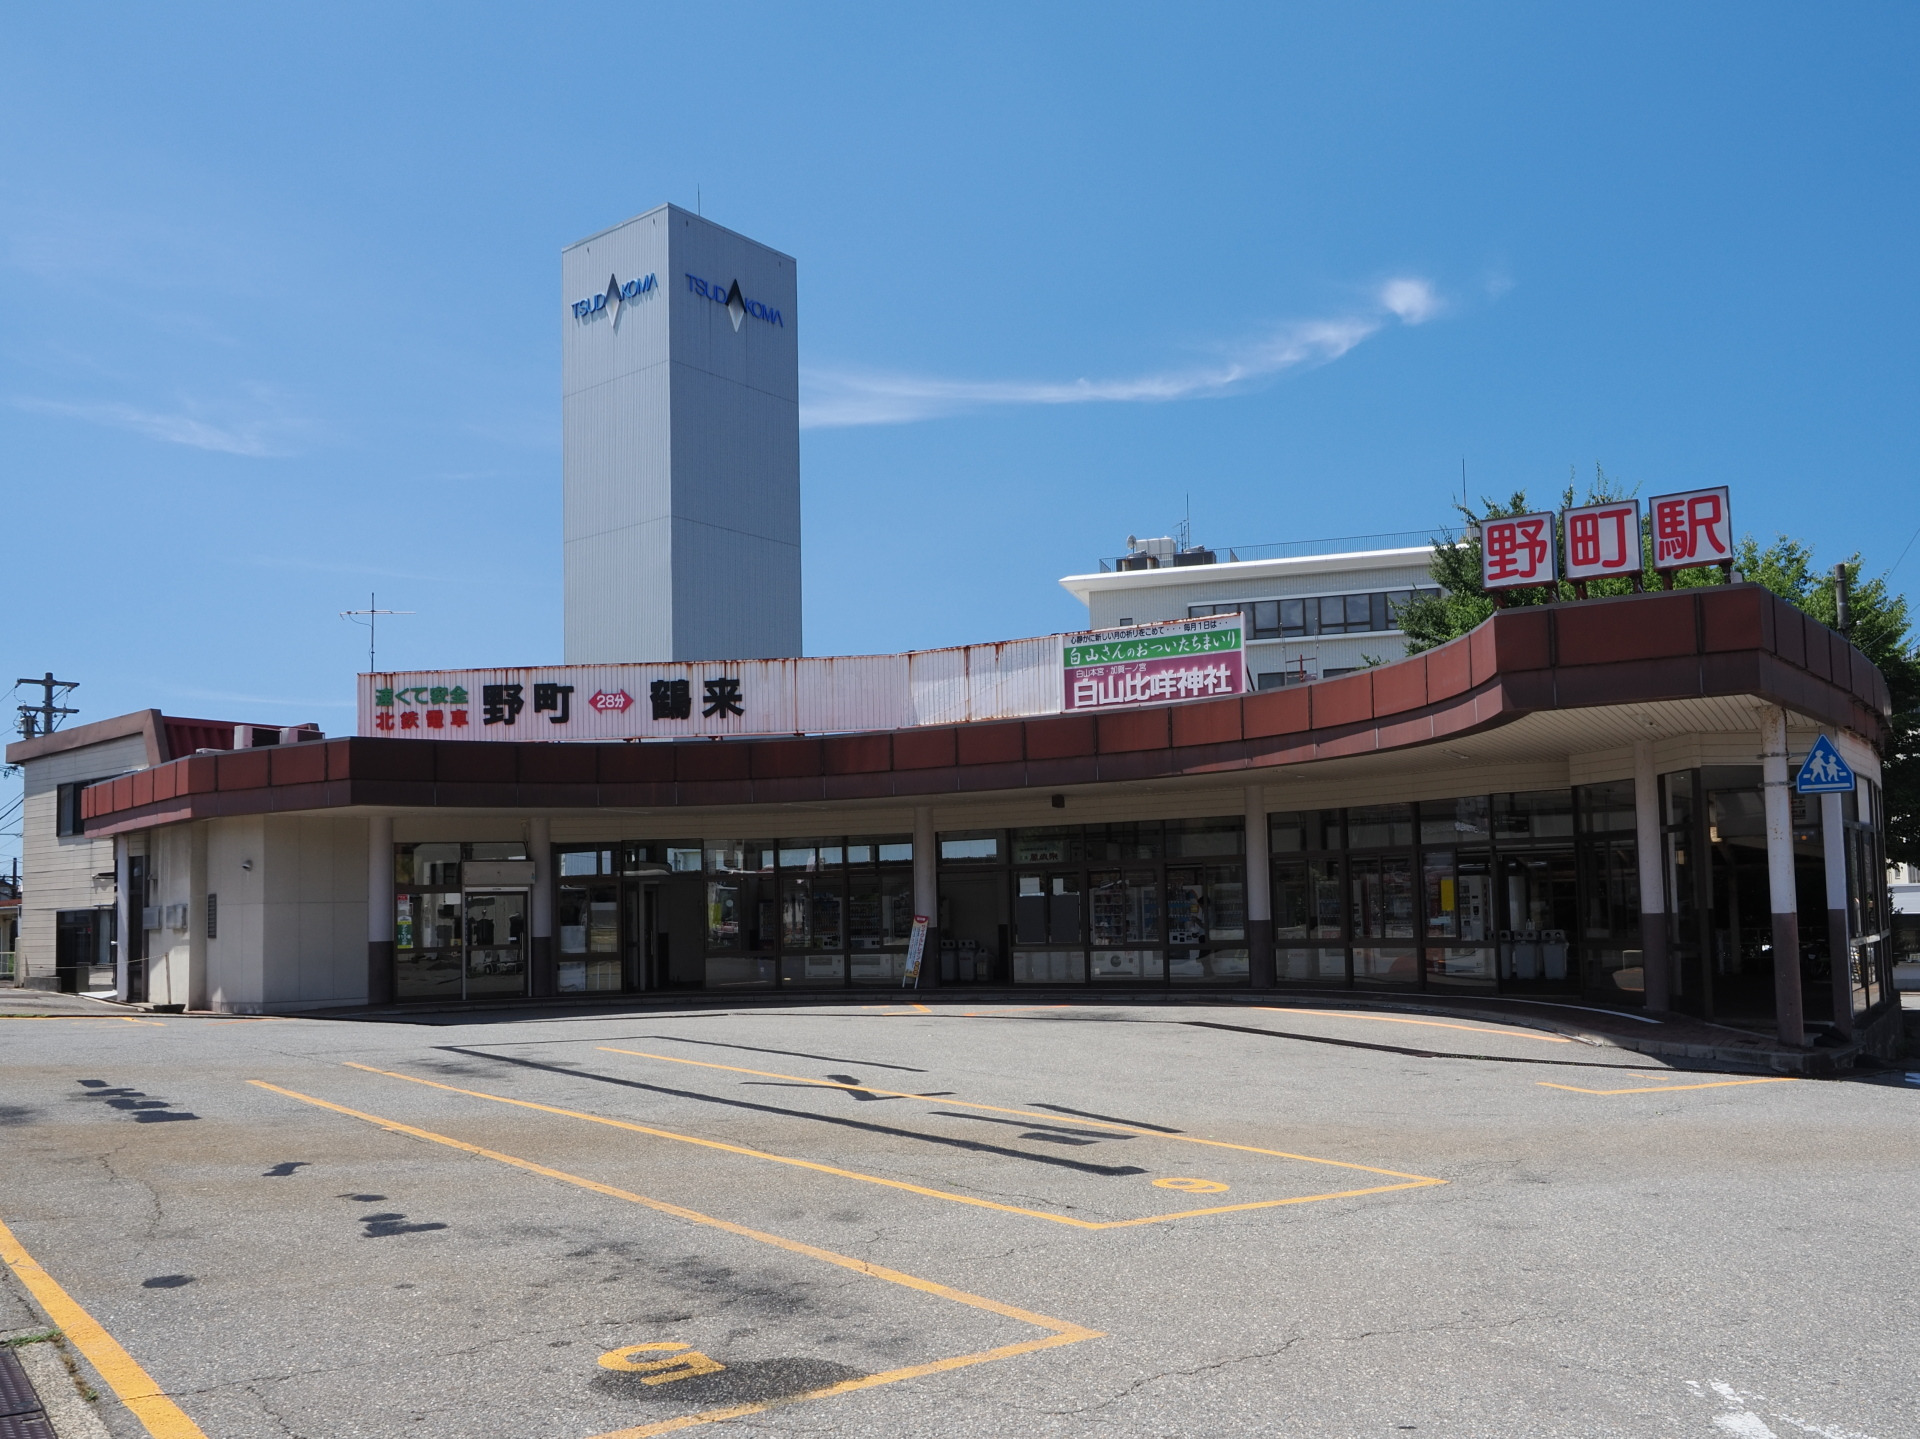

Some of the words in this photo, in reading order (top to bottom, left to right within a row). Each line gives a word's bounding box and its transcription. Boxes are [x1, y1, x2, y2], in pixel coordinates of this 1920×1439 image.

[1487, 494, 1726, 581] 野町駅
[1070, 631, 1235, 665] 白山さんのおついたちまいり
[483, 683, 574, 726] 野町
[597, 694, 625, 708] 28分
[650, 677, 744, 721] 鶴来
[1074, 663, 1232, 707] 白山比咩神社
[376, 709, 469, 731] 北鉄電車
[597, 1342, 727, 1385] 5
